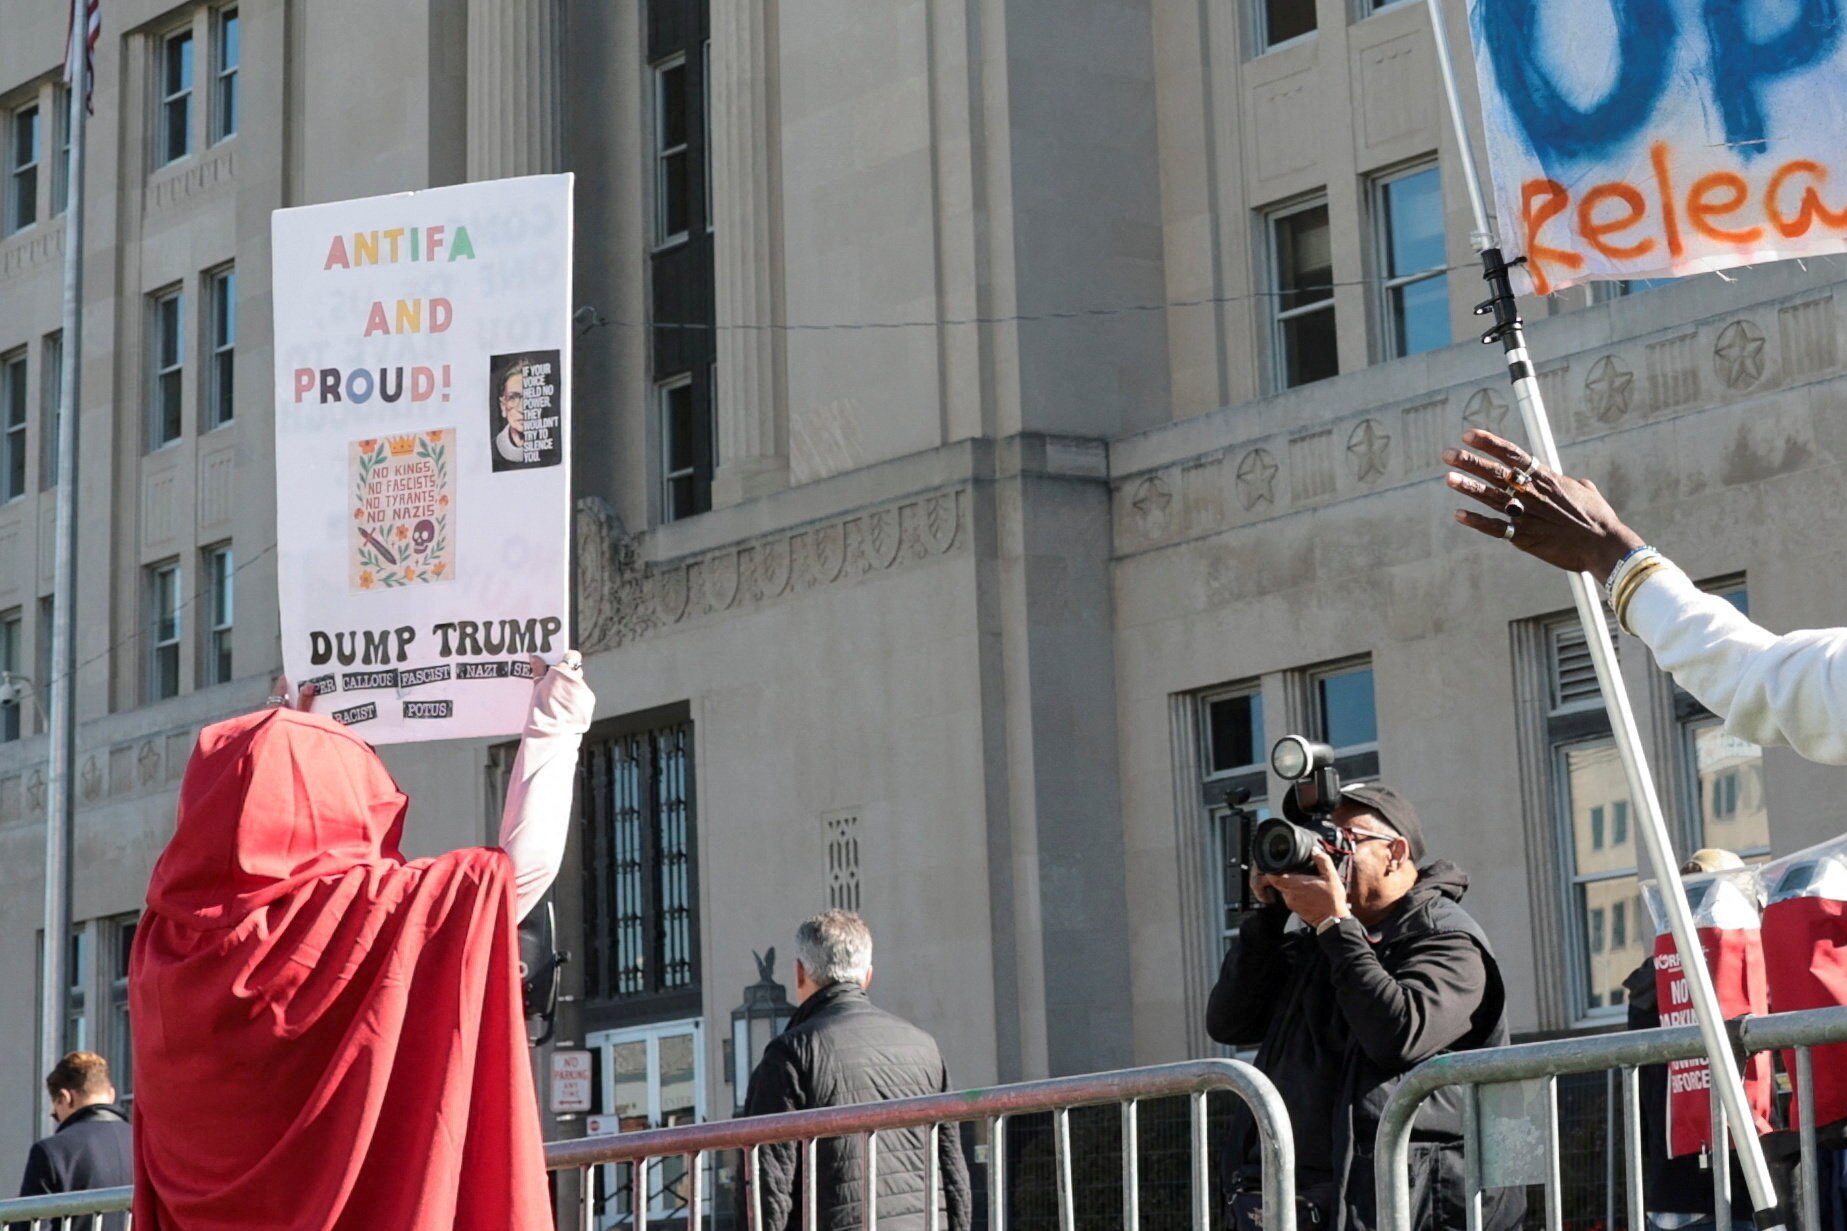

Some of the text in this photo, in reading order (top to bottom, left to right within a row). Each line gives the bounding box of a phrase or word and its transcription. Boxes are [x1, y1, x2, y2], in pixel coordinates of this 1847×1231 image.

[323, 225, 477, 270] ANTIFA
[363, 297, 454, 338] AND
[294, 365, 452, 404] PROUD!
[373, 466, 389, 479] NO
[368, 481, 382, 495] NO
[366, 496, 380, 510] NO
[367, 504, 435, 524] NO NAZIS
[310, 616, 561, 666] DUMP TRUMP
[343, 673, 394, 690] CALLOUS
[401, 666, 450, 687] FASCIST
[465, 664, 498, 678] NAZI
[334, 703, 447, 724] RACIST POTUS
[1671, 979, 1689, 1005] NO
[563, 1056, 579, 1067] NO
[554, 1070, 588, 1080] PARKING
